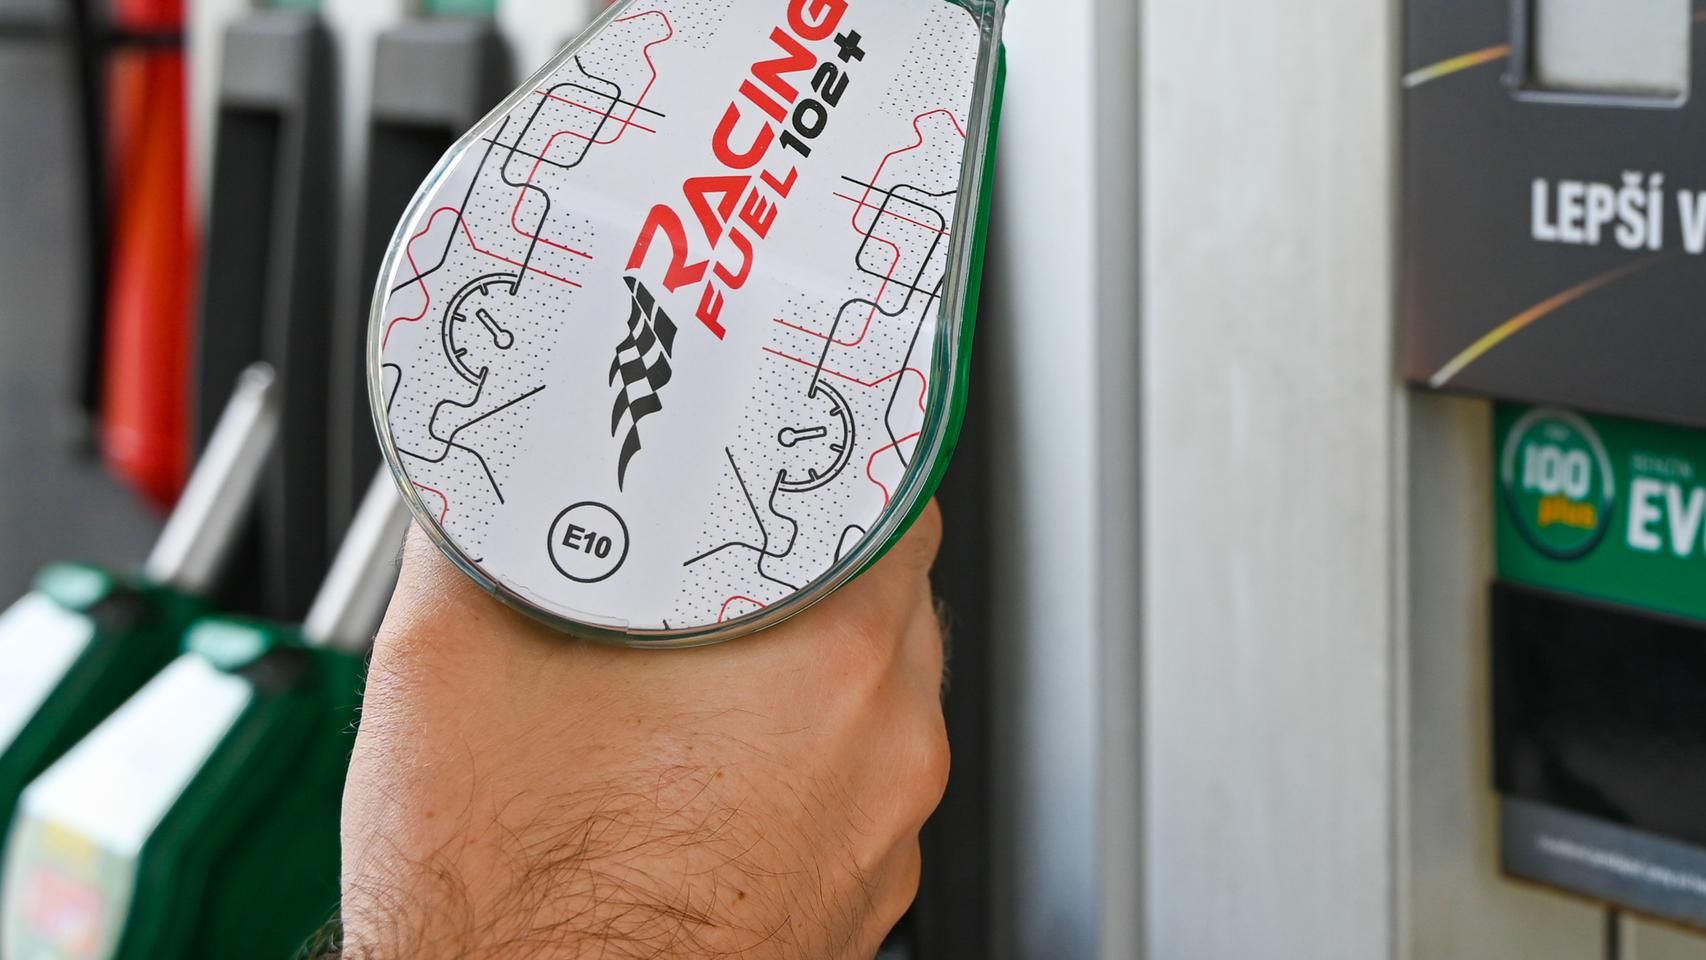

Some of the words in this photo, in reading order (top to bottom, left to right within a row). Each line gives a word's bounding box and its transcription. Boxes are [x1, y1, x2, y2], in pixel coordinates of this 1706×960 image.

[694, 164, 799, 341] FUEL
[779, 29, 866, 159] 102+
[1531, 170, 1664, 251] LEPŠÍ
[1523, 442, 1592, 501] 100
[562, 523, 613, 560] E10
